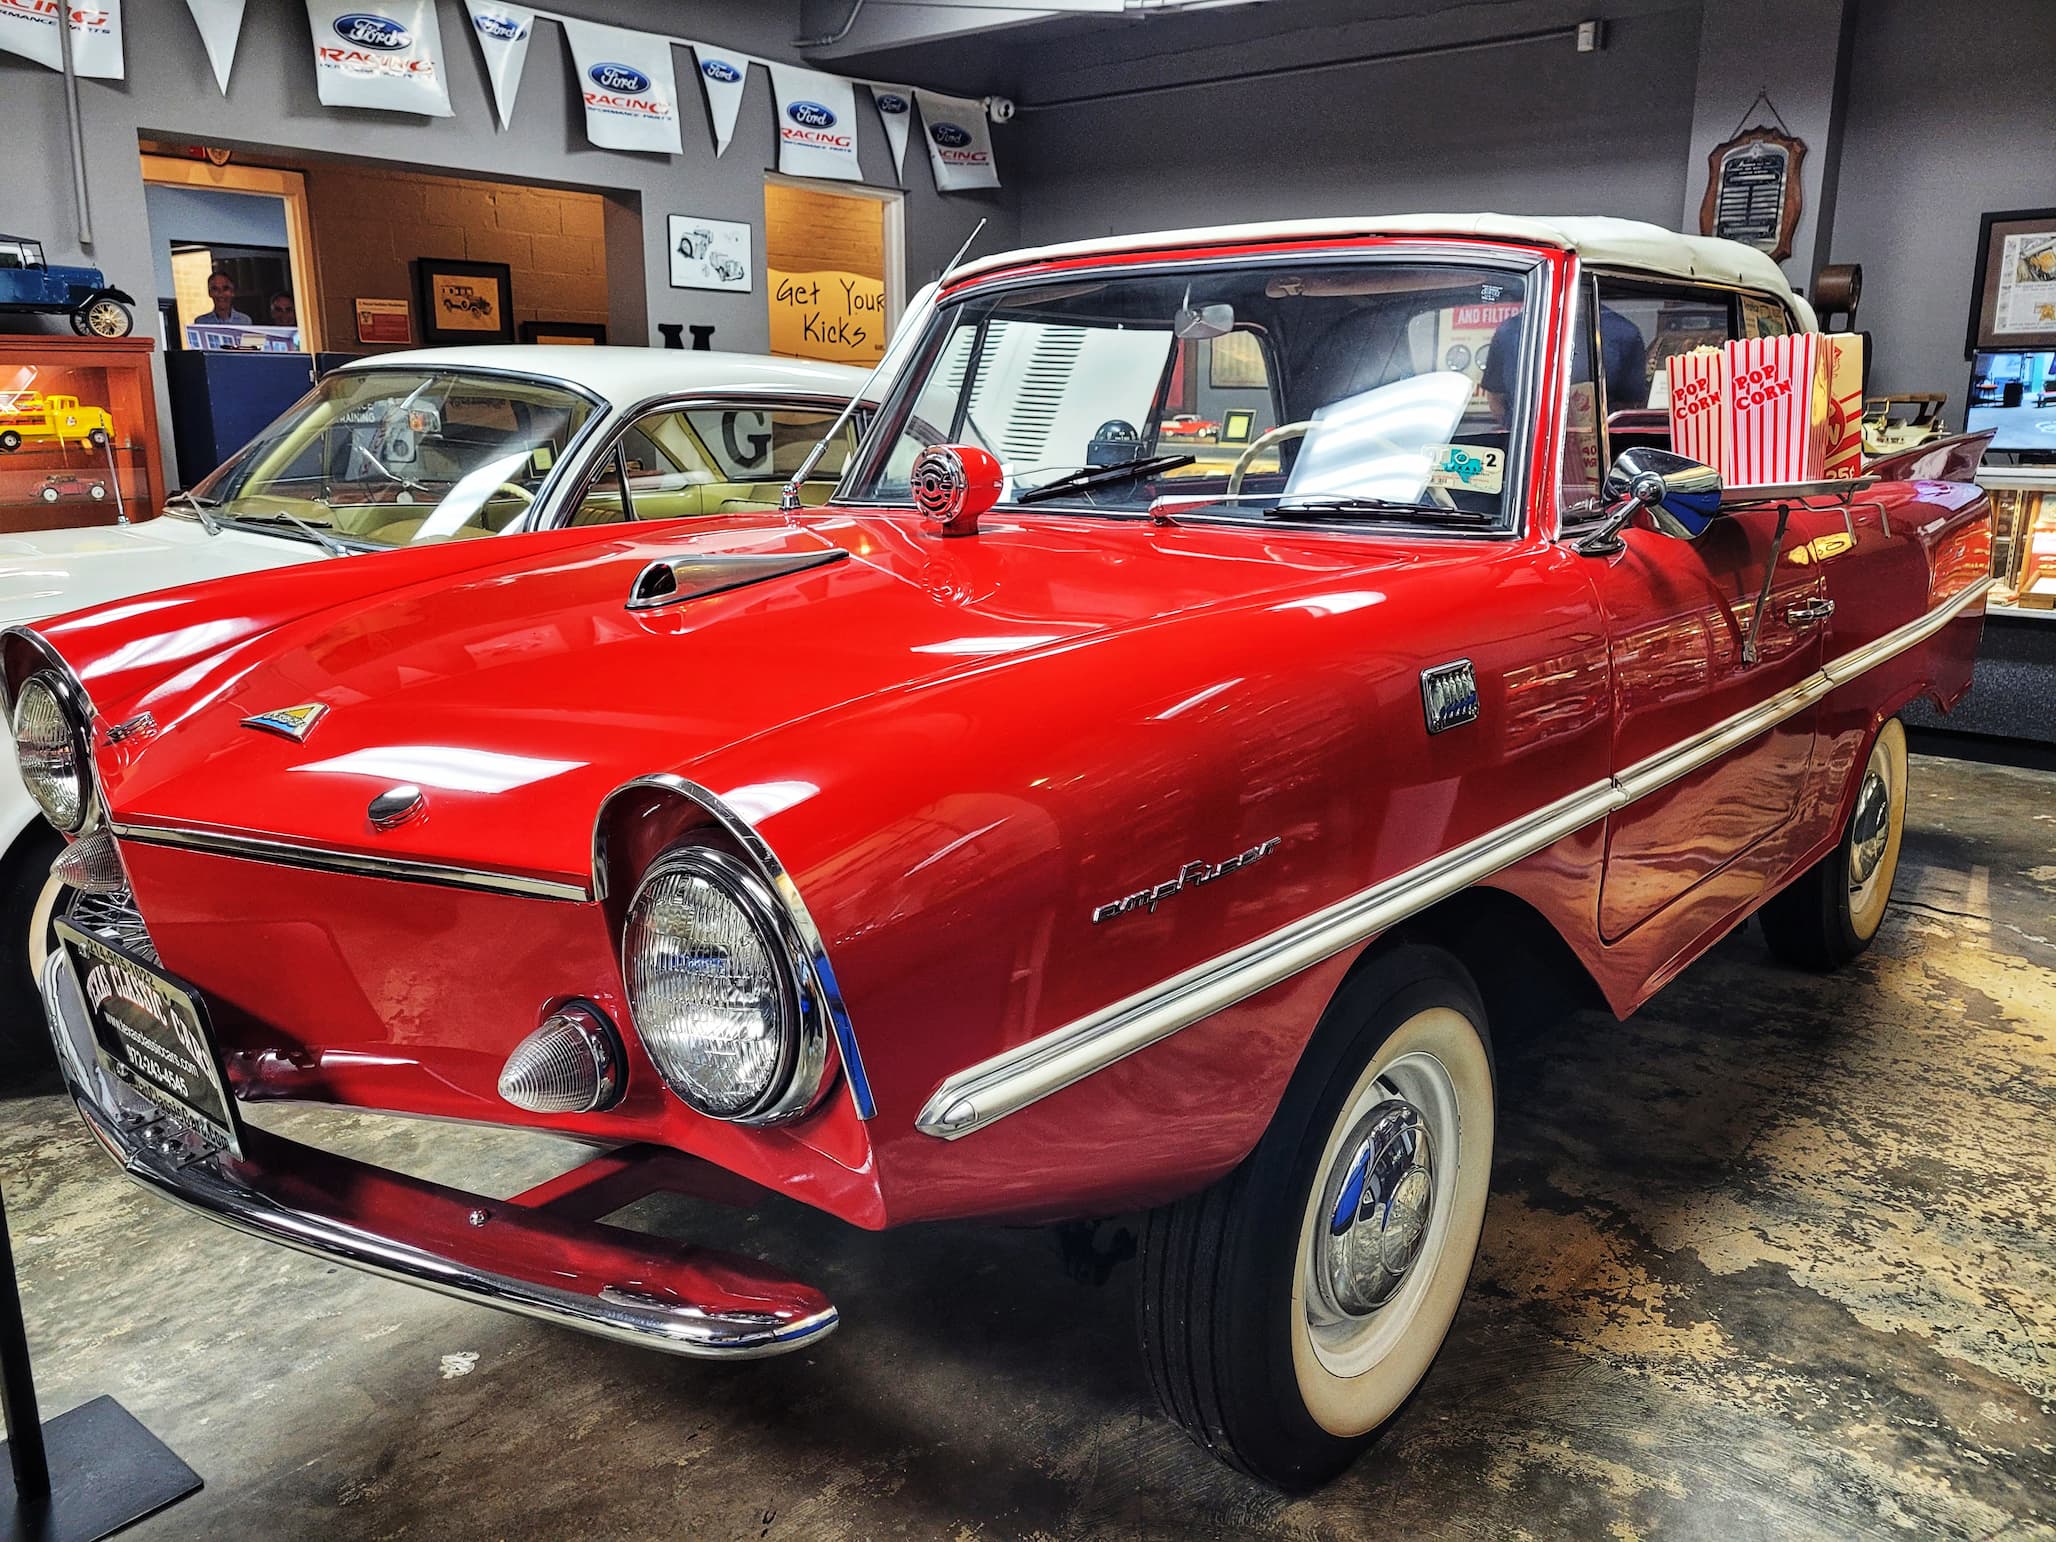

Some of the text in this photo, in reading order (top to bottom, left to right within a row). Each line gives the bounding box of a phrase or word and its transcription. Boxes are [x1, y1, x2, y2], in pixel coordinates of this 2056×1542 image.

[350, 18, 398, 47] Ford
[481, 16, 517, 38] Ford
[600, 67, 639, 91] Ford
[707, 63, 734, 81] Ford
[584, 92, 670, 115] RACING
[796, 104, 828, 126] Ford
[781, 127, 852, 147] RACING
[936, 126, 962, 144] Ford
[776, 279, 821, 306] Get
[1457, 308, 1481, 325] AND
[803, 311, 867, 348] Kicks
[1735, 365, 1775, 390] POP
[1675, 378, 1708, 401] POP
[1736, 380, 1792, 409] CORN
[1676, 393, 1721, 419] CORN
[1486, 453, 1497, 467] 2
[87, 964, 217, 1089] TEXAS CLASSIC CARS
[126, 1044, 189, 1098] 972-243-4545
